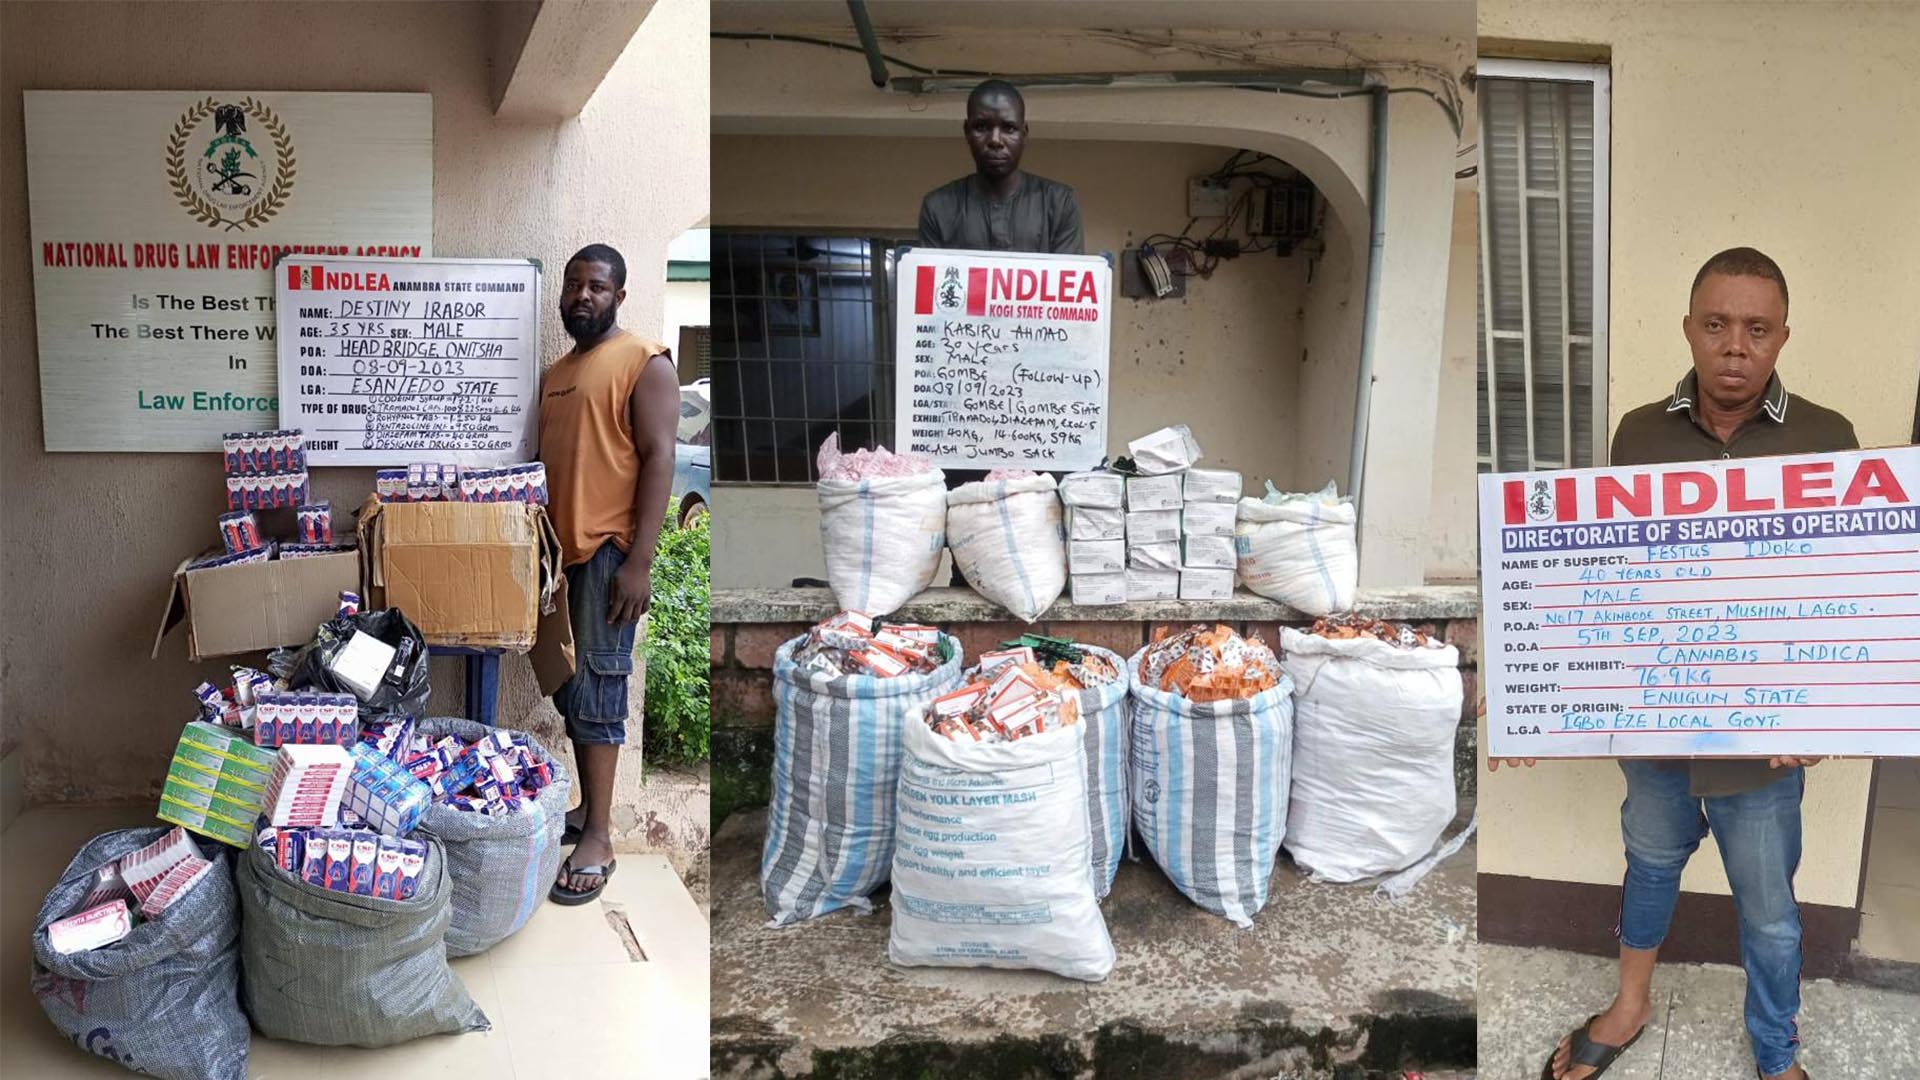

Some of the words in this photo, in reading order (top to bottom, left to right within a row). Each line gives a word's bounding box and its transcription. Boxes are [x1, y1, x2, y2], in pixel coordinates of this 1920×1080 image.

[43, 242, 128, 268] NATIONAL
[134, 243, 179, 269] DRUG
[186, 244, 220, 269] LAW
[327, 272, 390, 291] NDLEA
[393, 281, 441, 292] ANAMBRA
[444, 282, 472, 292] STATE
[475, 282, 525, 293] COMMAND
[991, 268, 1098, 304] NDLEA
[132, 294, 150, 310] Is
[156, 295, 195, 310] The
[202, 295, 249, 311] Best
[299, 308, 333, 319] NAME:
[341, 300, 411, 318] DESTINY
[423, 301, 486, 319] IRABOR
[989, 305, 1013, 318] KOGI
[1016, 306, 1043, 319] STATE
[1046, 306, 1098, 321] COMMAND
[91, 324, 129, 339] The
[137, 324, 184, 340] Best
[190, 325, 249, 340] There
[300, 327, 322, 337] AGE:
[330, 322, 350, 336] 35
[357, 322, 384, 336] YRS
[390, 328, 412, 339] SEX:
[423, 322, 464, 338] MALE
[944, 320, 1000, 340] KABIRU
[1010, 325, 1068, 341] AHMAD
[300, 346, 326, 357] POA:
[341, 339, 380, 357] HEAD
[446, 341, 503, 358] ONITSHA
[915, 340, 936, 348] AGE:
[940, 338, 962, 354] 30
[229, 355, 247, 370] In
[300, 365, 327, 376] DOA:
[353, 359, 464, 376] 08-09-2023
[915, 355, 934, 363] SEX:
[301, 384, 326, 395] LGA:
[351, 376, 445, 395] ESAN/EDO
[452, 381, 499, 395] STATE
[933, 379, 1023, 397] 08/09/2023
[138, 390, 184, 410] Law
[193, 391, 279, 411] Enforce
[301, 404, 324, 413] TYPE
[327, 404, 338, 414] OF
[375, 440, 425, 449] DESIGNER
[429, 440, 461, 449] DRUGS
[964, 444, 1015, 459] JUMBO
[1023, 448, 1056, 460] SACK
[1596, 458, 1910, 519] NDLEA
[1505, 524, 1639, 549] DIRECTORATE
[1645, 523, 1671, 542] OF
[1678, 516, 1785, 540] SEAPORTS
[1792, 510, 1916, 535] OPERATION
[1502, 559, 1538, 570] NAME
[1542, 558, 1559, 568] OF
[1564, 556, 1628, 567] SUSPECT:
[1647, 544, 1710, 562] FESTUS
[1502, 581, 1532, 590] AGE:
[1579, 568, 1605, 584] 40
[1616, 568, 1661, 580] YEARS
[1676, 566, 1712, 577] OLD
[1503, 601, 1532, 611] SEX:
[1583, 588, 1641, 605] MALE
[1503, 622, 1539, 632] P.O.A:
[1504, 643, 1539, 652] D.O.A
[1578, 629, 1610, 645] 5TH
[1677, 624, 1738, 642] 2023
[1504, 663, 1539, 673] TYPE
[1542, 662, 1560, 672] OF
[1567, 661, 1625, 671] EXHIBIT:
[1657, 647, 1758, 664] CANNABIS
[1783, 642, 1870, 662] INDICA
[1505, 683, 1561, 693] WEIGHT:
[1506, 704, 1546, 714] STATE
[1551, 704, 1568, 713] OF
[1572, 703, 1624, 713] ORIGIN:
[1643, 689, 1728, 705] ENUGUN
[1744, 687, 1808, 705] STATE
[1507, 726, 1541, 735] L.G.A
[1561, 713, 1605, 730] IGBO
[1614, 714, 1646, 728] EZE
[1657, 713, 1712, 729] LOCAL
[930, 795, 959, 805] YOLK
[962, 794, 1000, 805] LAYER
[1003, 791, 1037, 803] MASH
[923, 829, 939, 841] egg
[941, 832, 997, 843] production
[958, 867, 977, 877] and
[979, 866, 1024, 878] efficient
